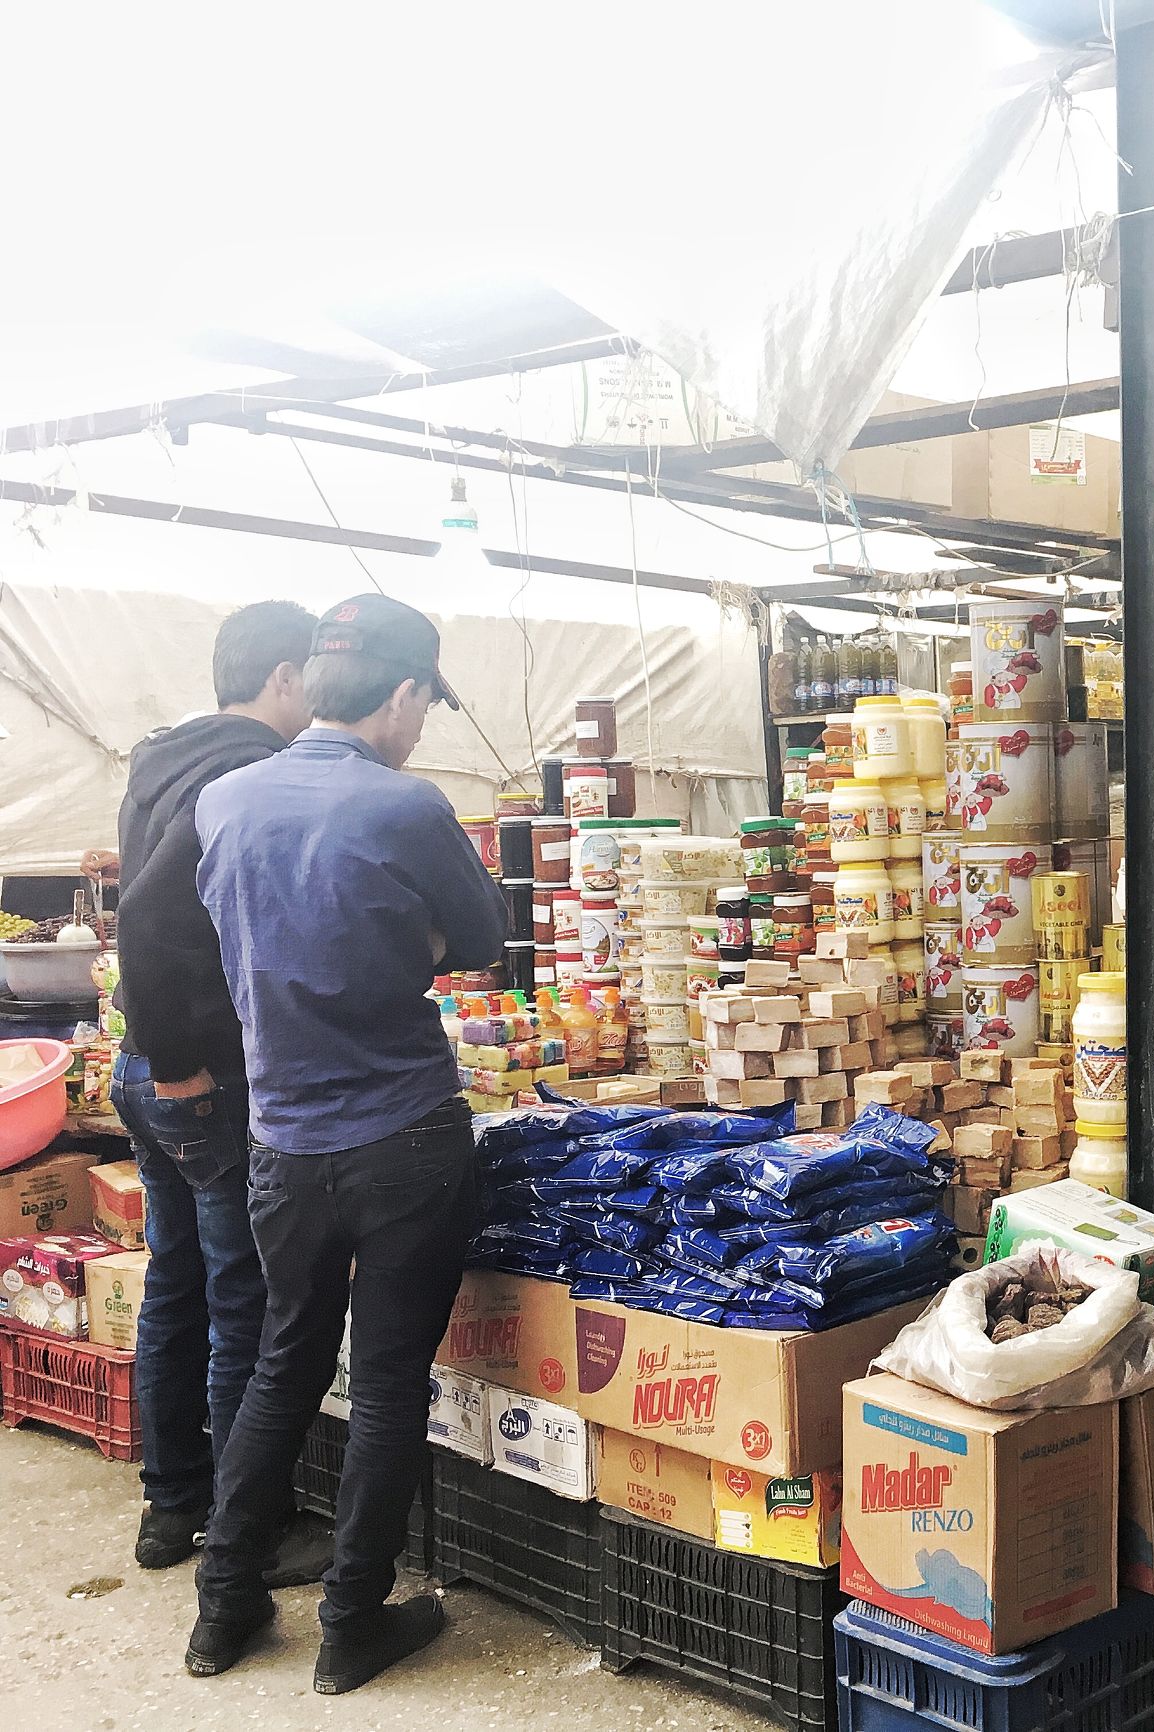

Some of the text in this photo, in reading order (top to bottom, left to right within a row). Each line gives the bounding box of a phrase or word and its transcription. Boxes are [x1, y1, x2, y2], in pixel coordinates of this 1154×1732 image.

[105, 1297, 133, 1314] Green
[449, 1315, 523, 1363] NOURA
[636, 1343, 671, 1379] نورا
[632, 1374, 720, 1429] NOURA
[675, 1425, 715, 1437] Multi-Usage
[770, 1485, 786, 1500] Lahn
[793, 1484, 811, 1499] Sham
[861, 1451, 953, 1513] Madar
[658, 1492, 677, 1507] 509
[659, 1507, 672, 1520] 12
[911, 1508, 974, 1533] RENZO
[852, 1568, 867, 1581] Anti
[845, 1577, 873, 1597] Bacterial
[914, 1608, 990, 1650] Dishwashing Liquid
